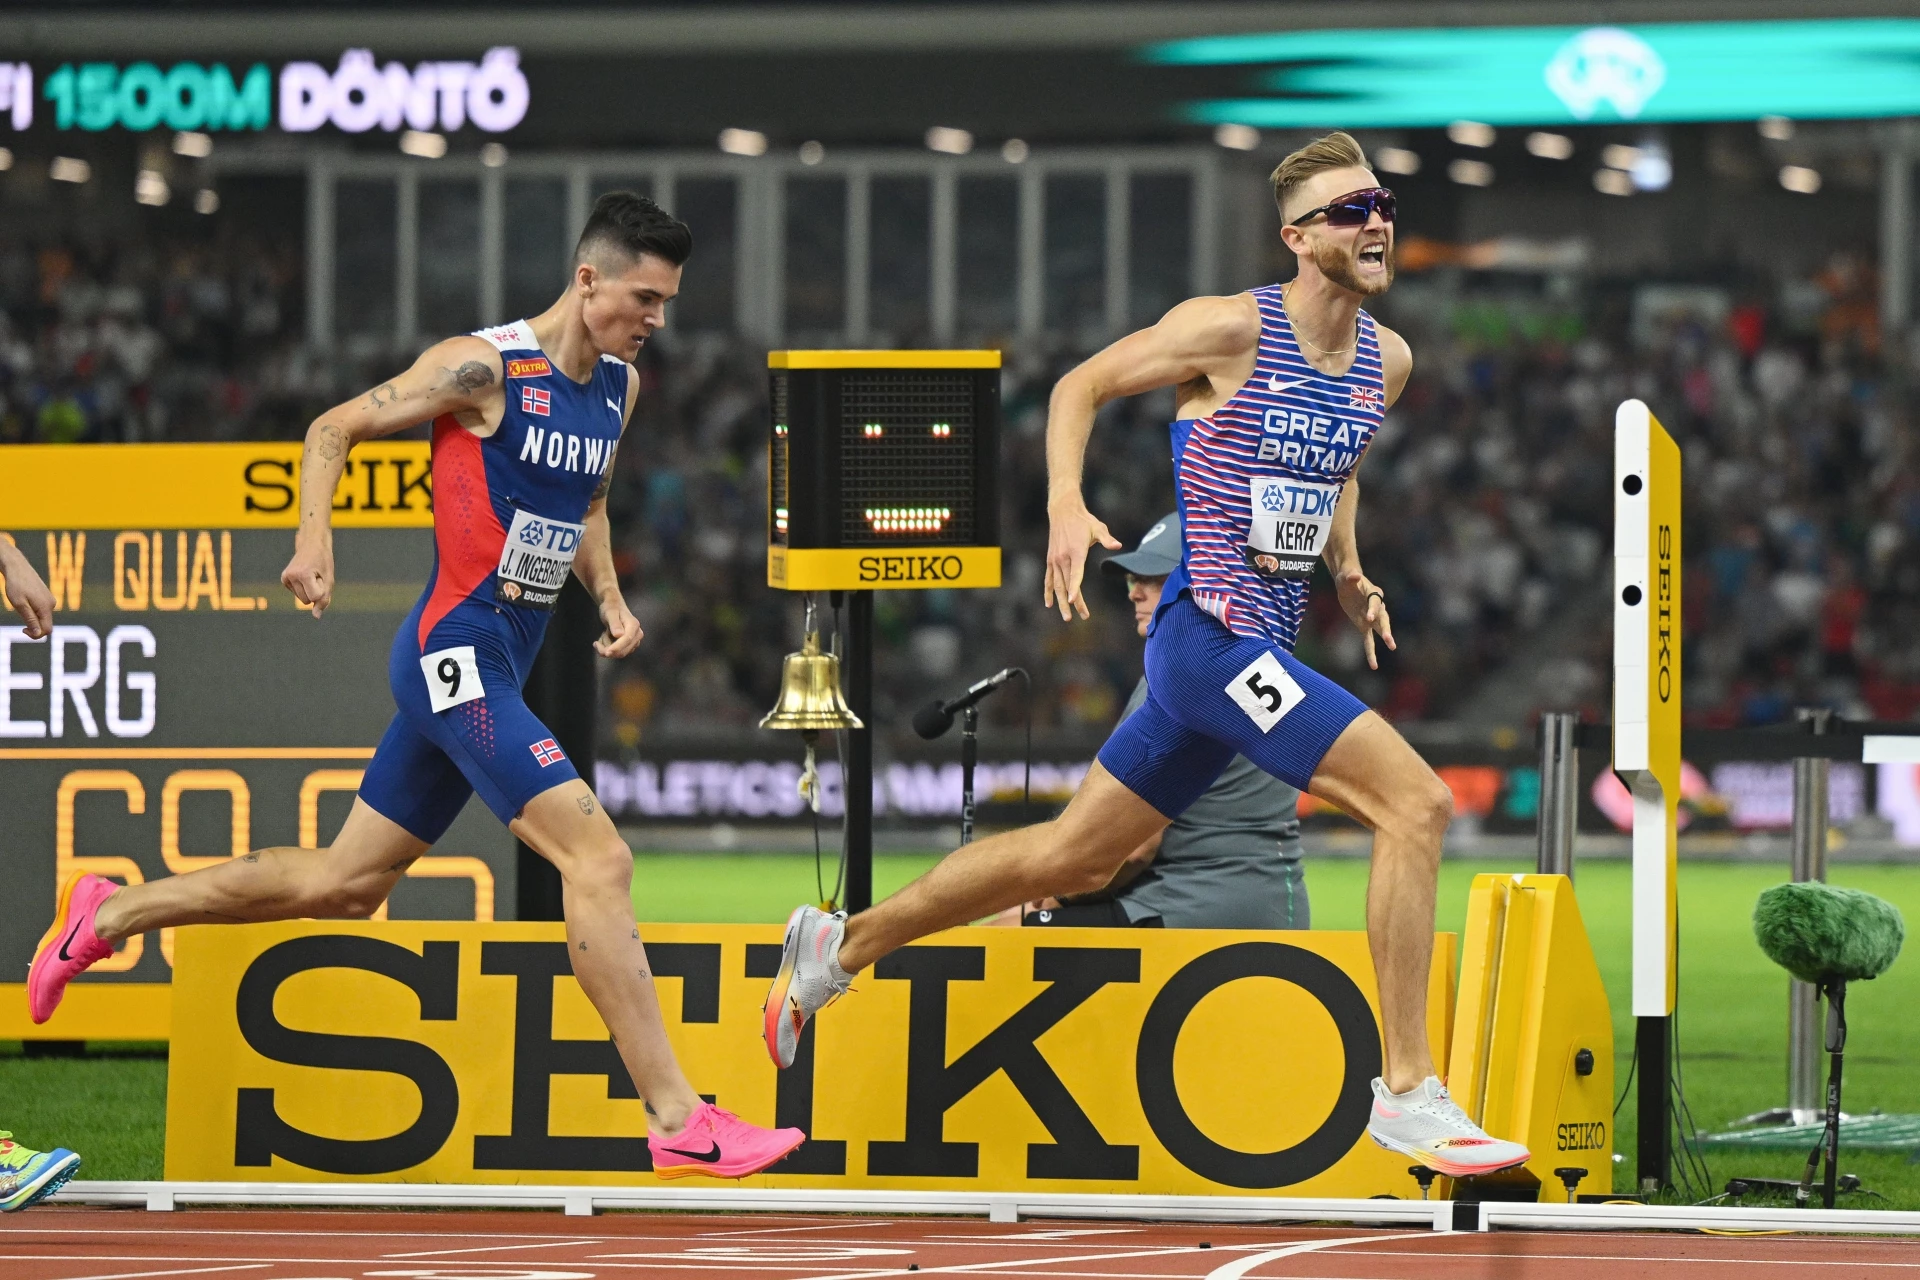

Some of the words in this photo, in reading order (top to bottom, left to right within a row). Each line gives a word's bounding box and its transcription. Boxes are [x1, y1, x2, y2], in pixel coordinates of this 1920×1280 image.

[43, 61, 272, 132] 1500M
[521, 361, 548, 373] EXTRA
[1263, 408, 1370, 449] GREAT
[1284, 485, 1338, 517] TDK
[1275, 520, 1319, 552] KERR
[46, 530, 87, 612] W
[113, 530, 268, 612] QUAL.
[502, 548, 515, 575] J.
[859, 555, 963, 582] SEIKO
[1658, 524, 1672, 704] SEIKO
[437, 657, 462, 698] 9
[1245, 671, 1283, 714] 5
[235, 933, 1382, 1190] SEIKO
[1448, 1139, 1482, 1147] BROOKS
[1557, 1121, 1605, 1151] SEIKO
